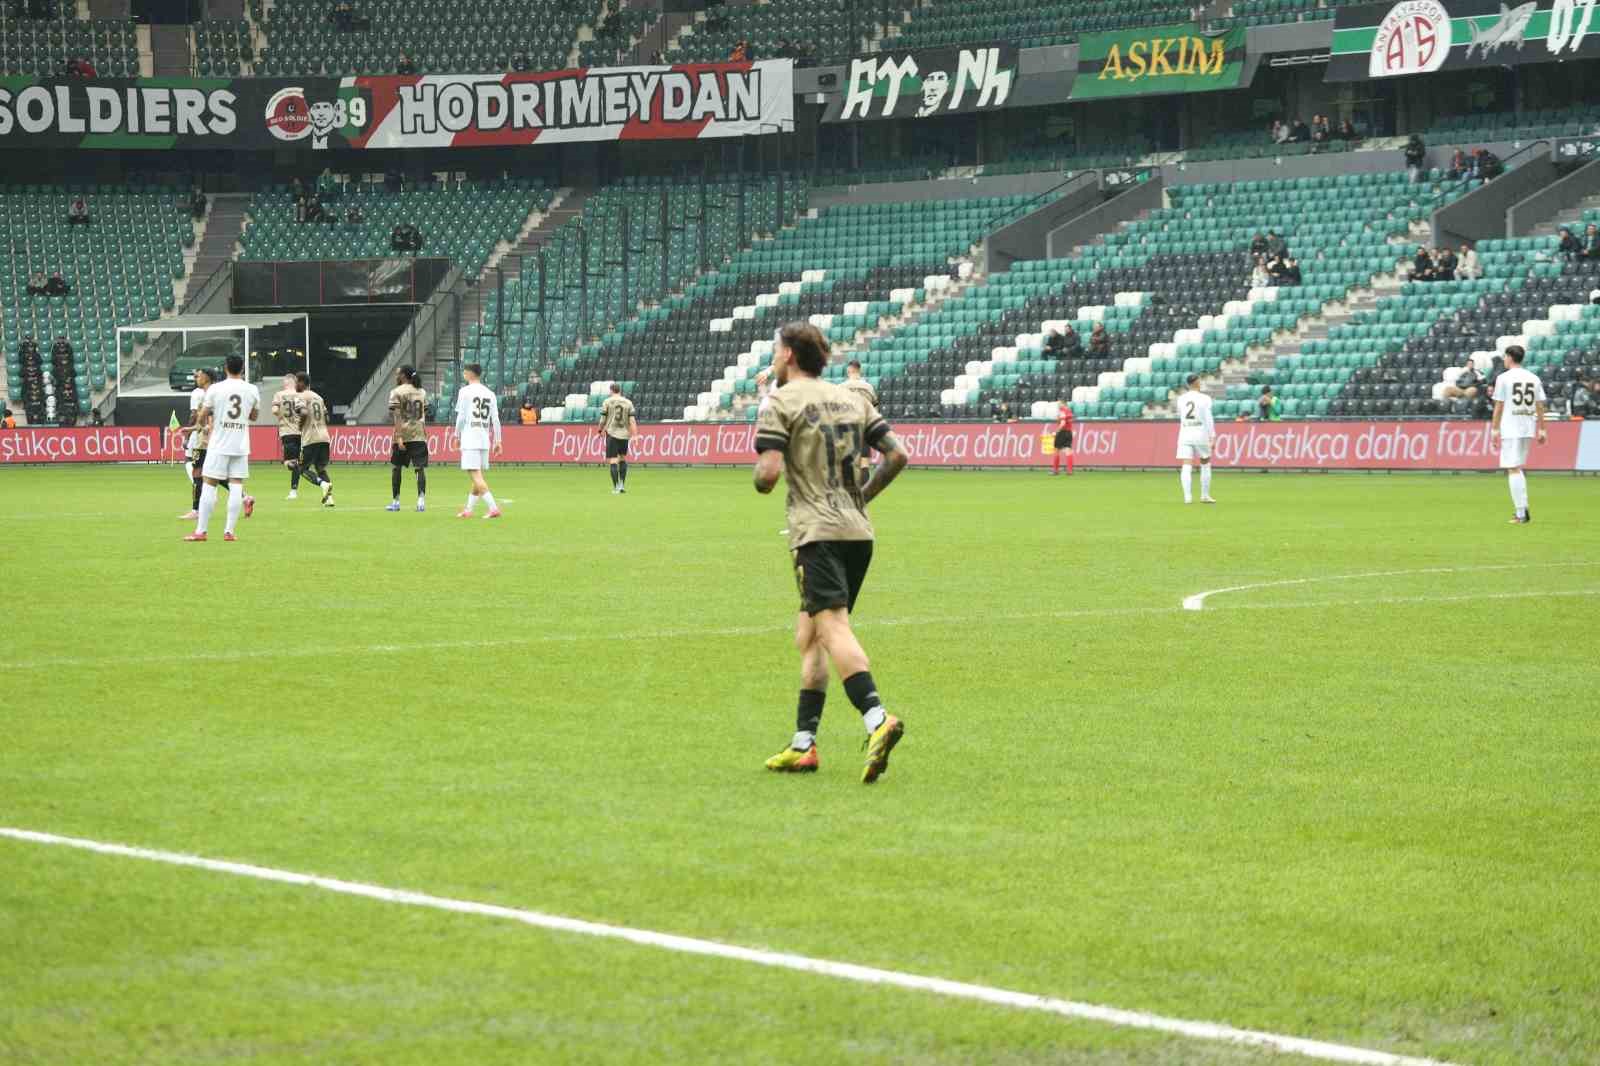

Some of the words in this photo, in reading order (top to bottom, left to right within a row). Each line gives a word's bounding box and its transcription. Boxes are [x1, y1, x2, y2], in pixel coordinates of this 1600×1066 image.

[1097, 35, 1225, 81] AŞKIM
[227, 393, 242, 420] 3
[1511, 381, 1535, 406] 55
[472, 395, 491, 420] 35
[1185, 400, 1196, 420] 2
[84, 430, 152, 456] daha
[660, 428, 709, 457] daha
[974, 428, 1034, 459] daha
[1355, 425, 1430, 460] daha
